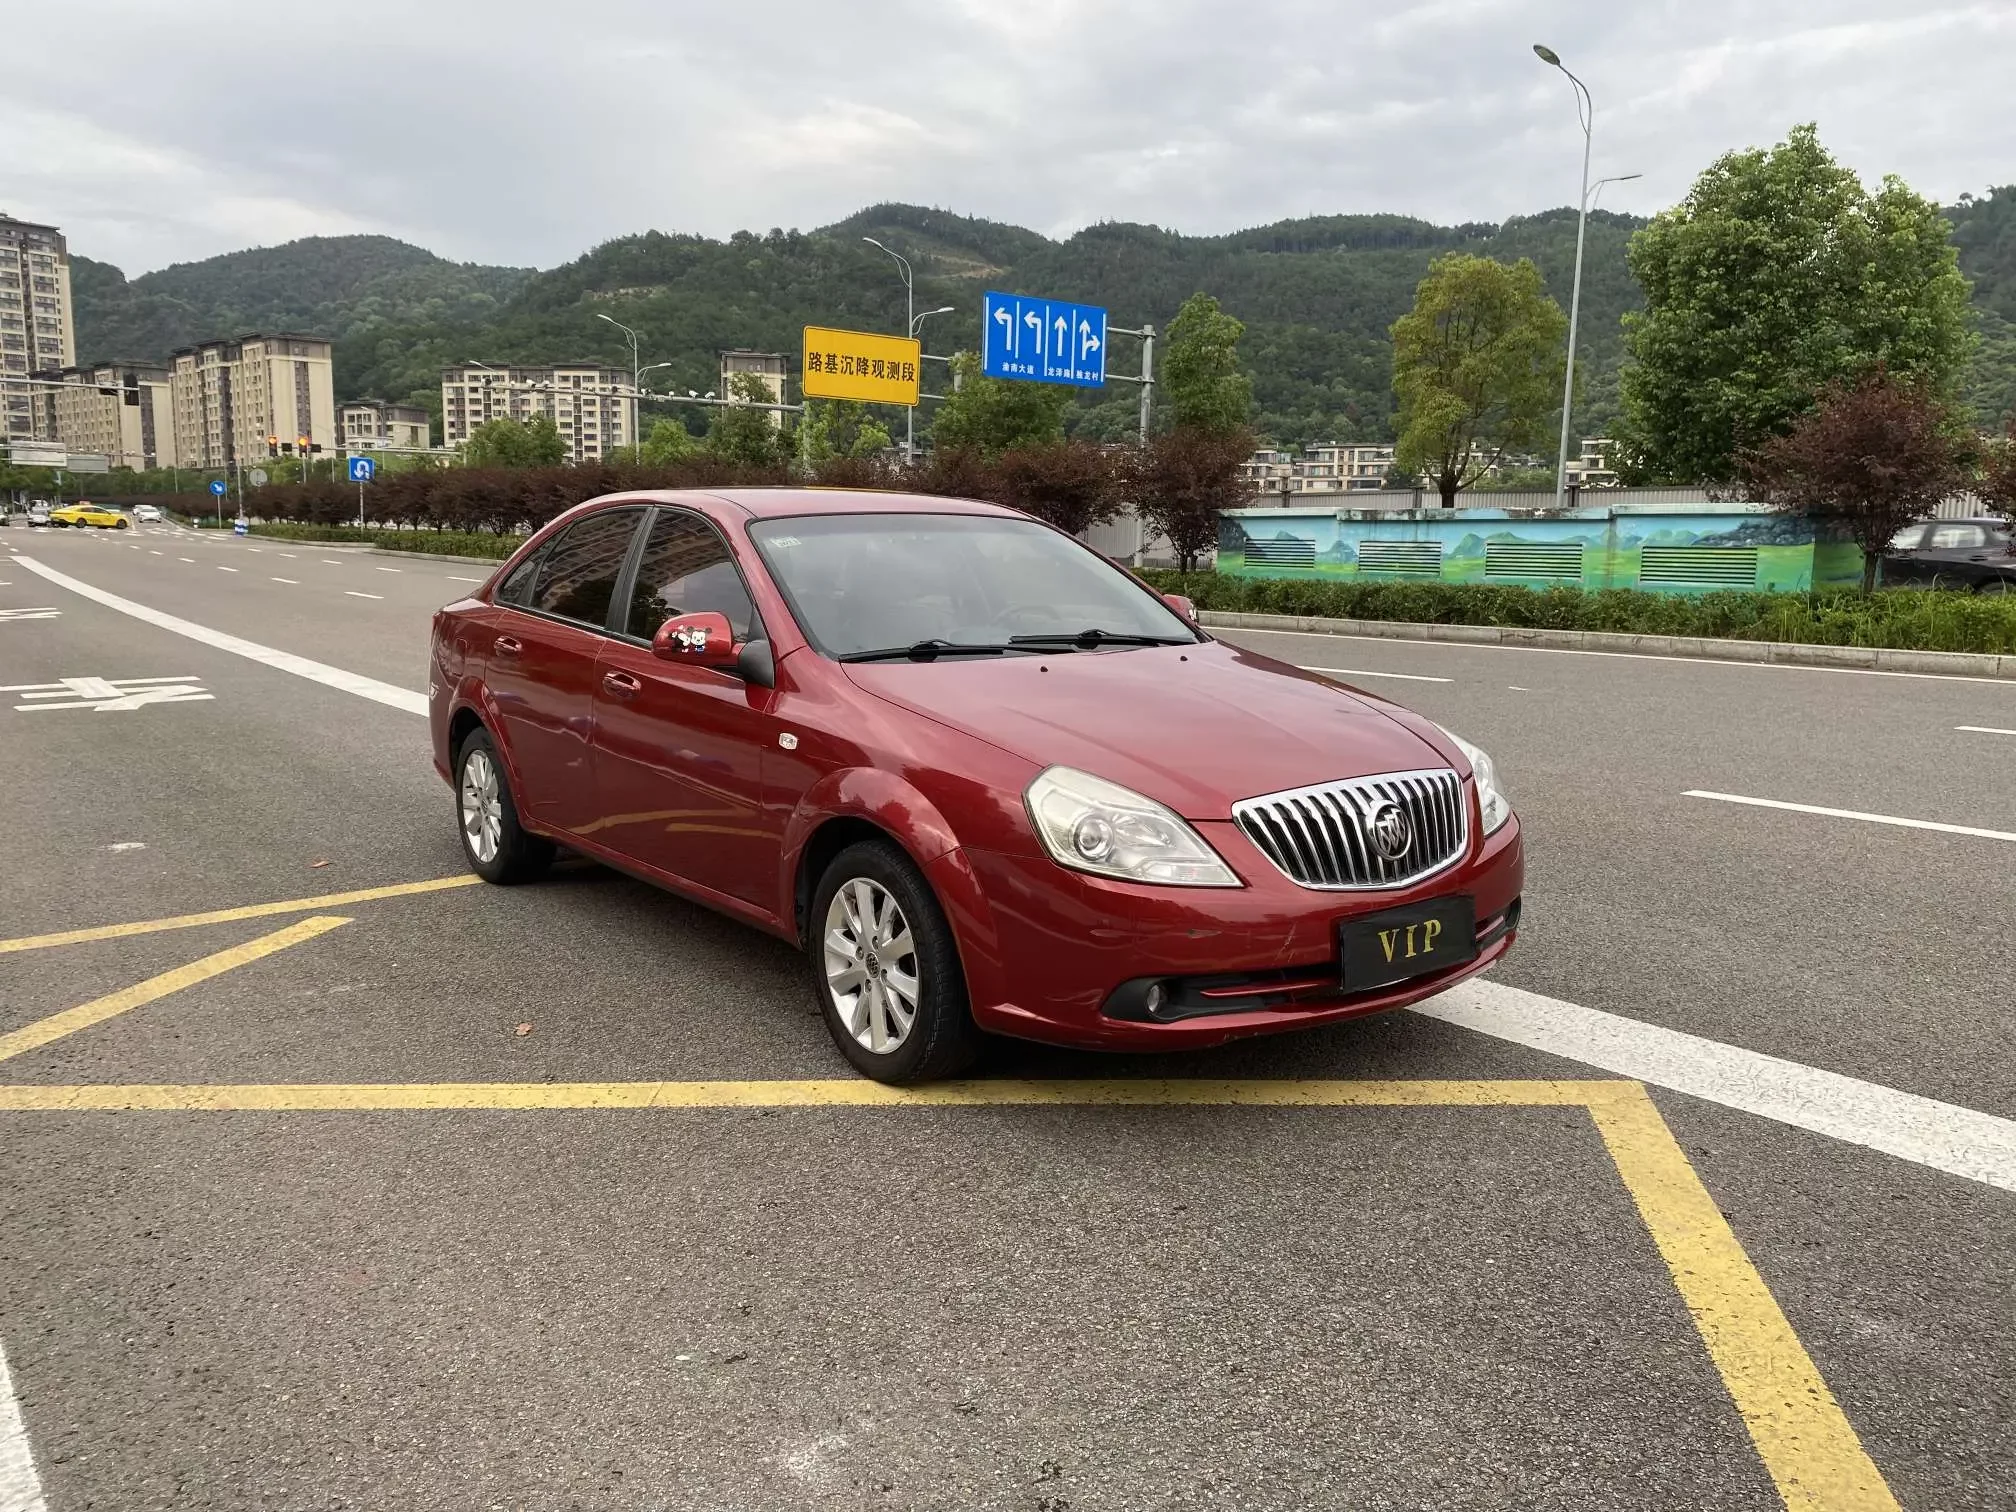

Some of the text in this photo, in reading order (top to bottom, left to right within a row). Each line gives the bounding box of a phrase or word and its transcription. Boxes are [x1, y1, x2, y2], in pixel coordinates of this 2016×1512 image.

[808, 351, 915, 382] 路基沉降观测段
[1378, 919, 1441, 963] VIP
